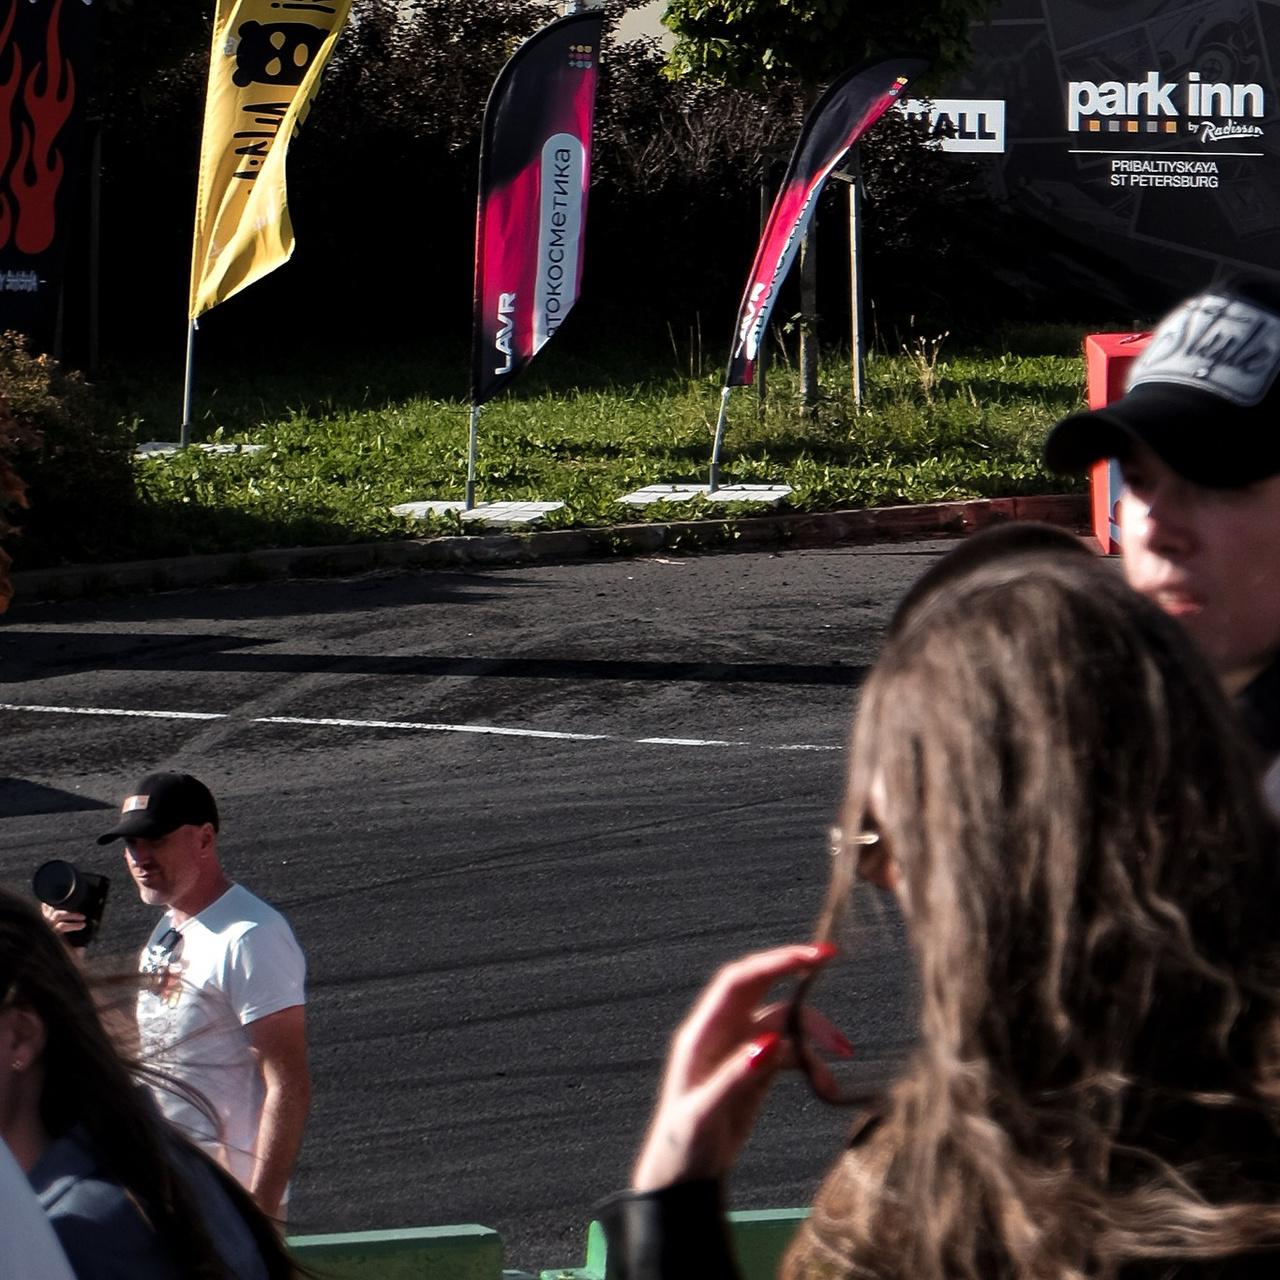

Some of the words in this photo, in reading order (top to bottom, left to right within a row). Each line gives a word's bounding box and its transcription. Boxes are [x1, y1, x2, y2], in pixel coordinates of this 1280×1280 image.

[1068, 71, 1179, 132] park
[1188, 71, 1265, 118] inn
[1187, 121, 1200, 134] by
[1201, 119, 1265, 144] Radisson
[1111, 160, 1219, 174] PRIBALTIYSKAYA
[1110, 174, 1126, 186] ST
[1130, 175, 1219, 188] PETERSBURG
[495, 292, 517, 376] LAVR
